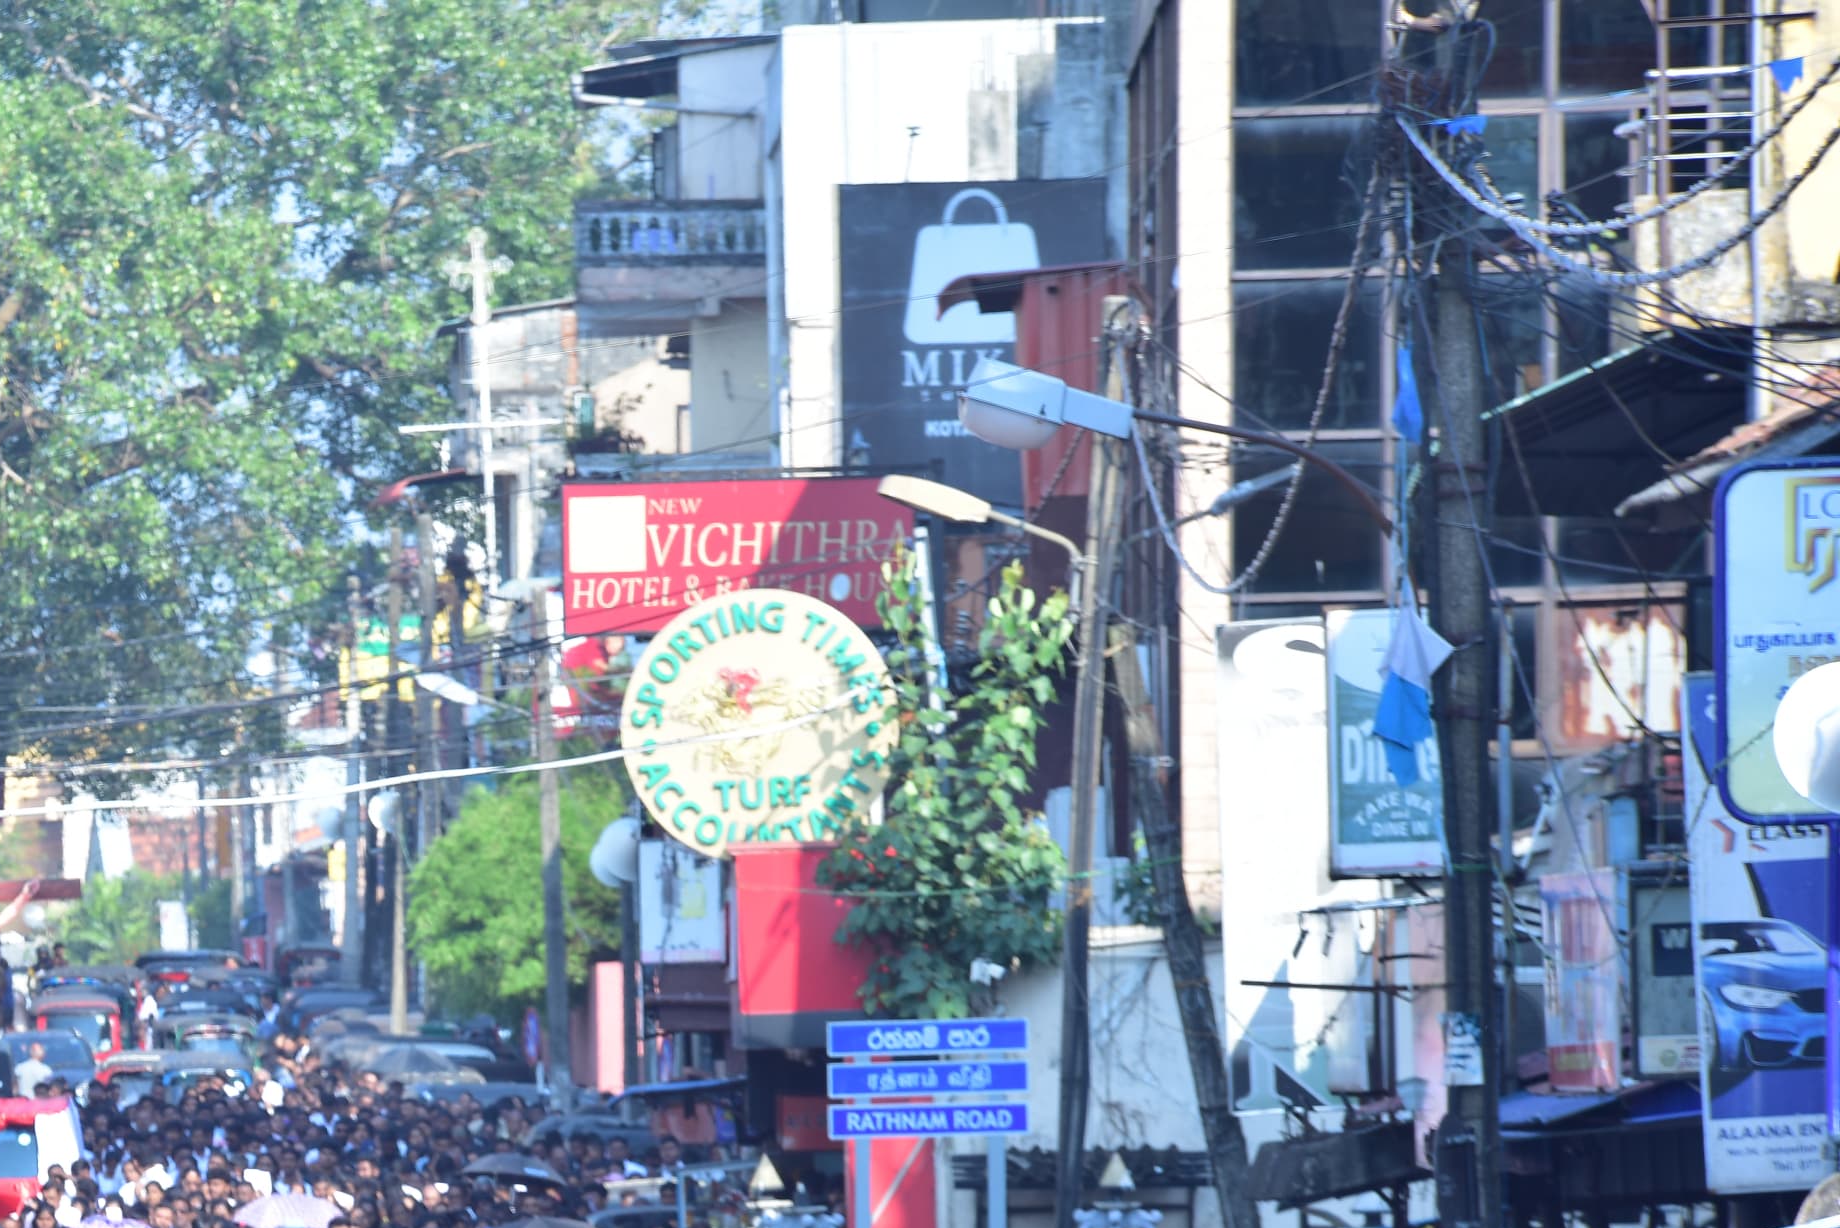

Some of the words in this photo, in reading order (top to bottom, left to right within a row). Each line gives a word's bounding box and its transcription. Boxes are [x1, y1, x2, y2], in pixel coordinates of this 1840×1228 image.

[648, 497, 703, 515] NEW
[647, 519, 908, 567] VICHITHRA
[572, 576, 677, 609] HOTEL
[683, 574, 707, 606] &
[630, 601, 786, 729] SPORTING
[800, 610, 885, 715] TIMES
[712, 773, 812, 812] TURF
[1371, 821, 1409, 838] DINE
[1411, 820, 1429, 837] IN
[847, 1110, 949, 1132] RATHNAM
[953, 1108, 1013, 1130] ROAD
